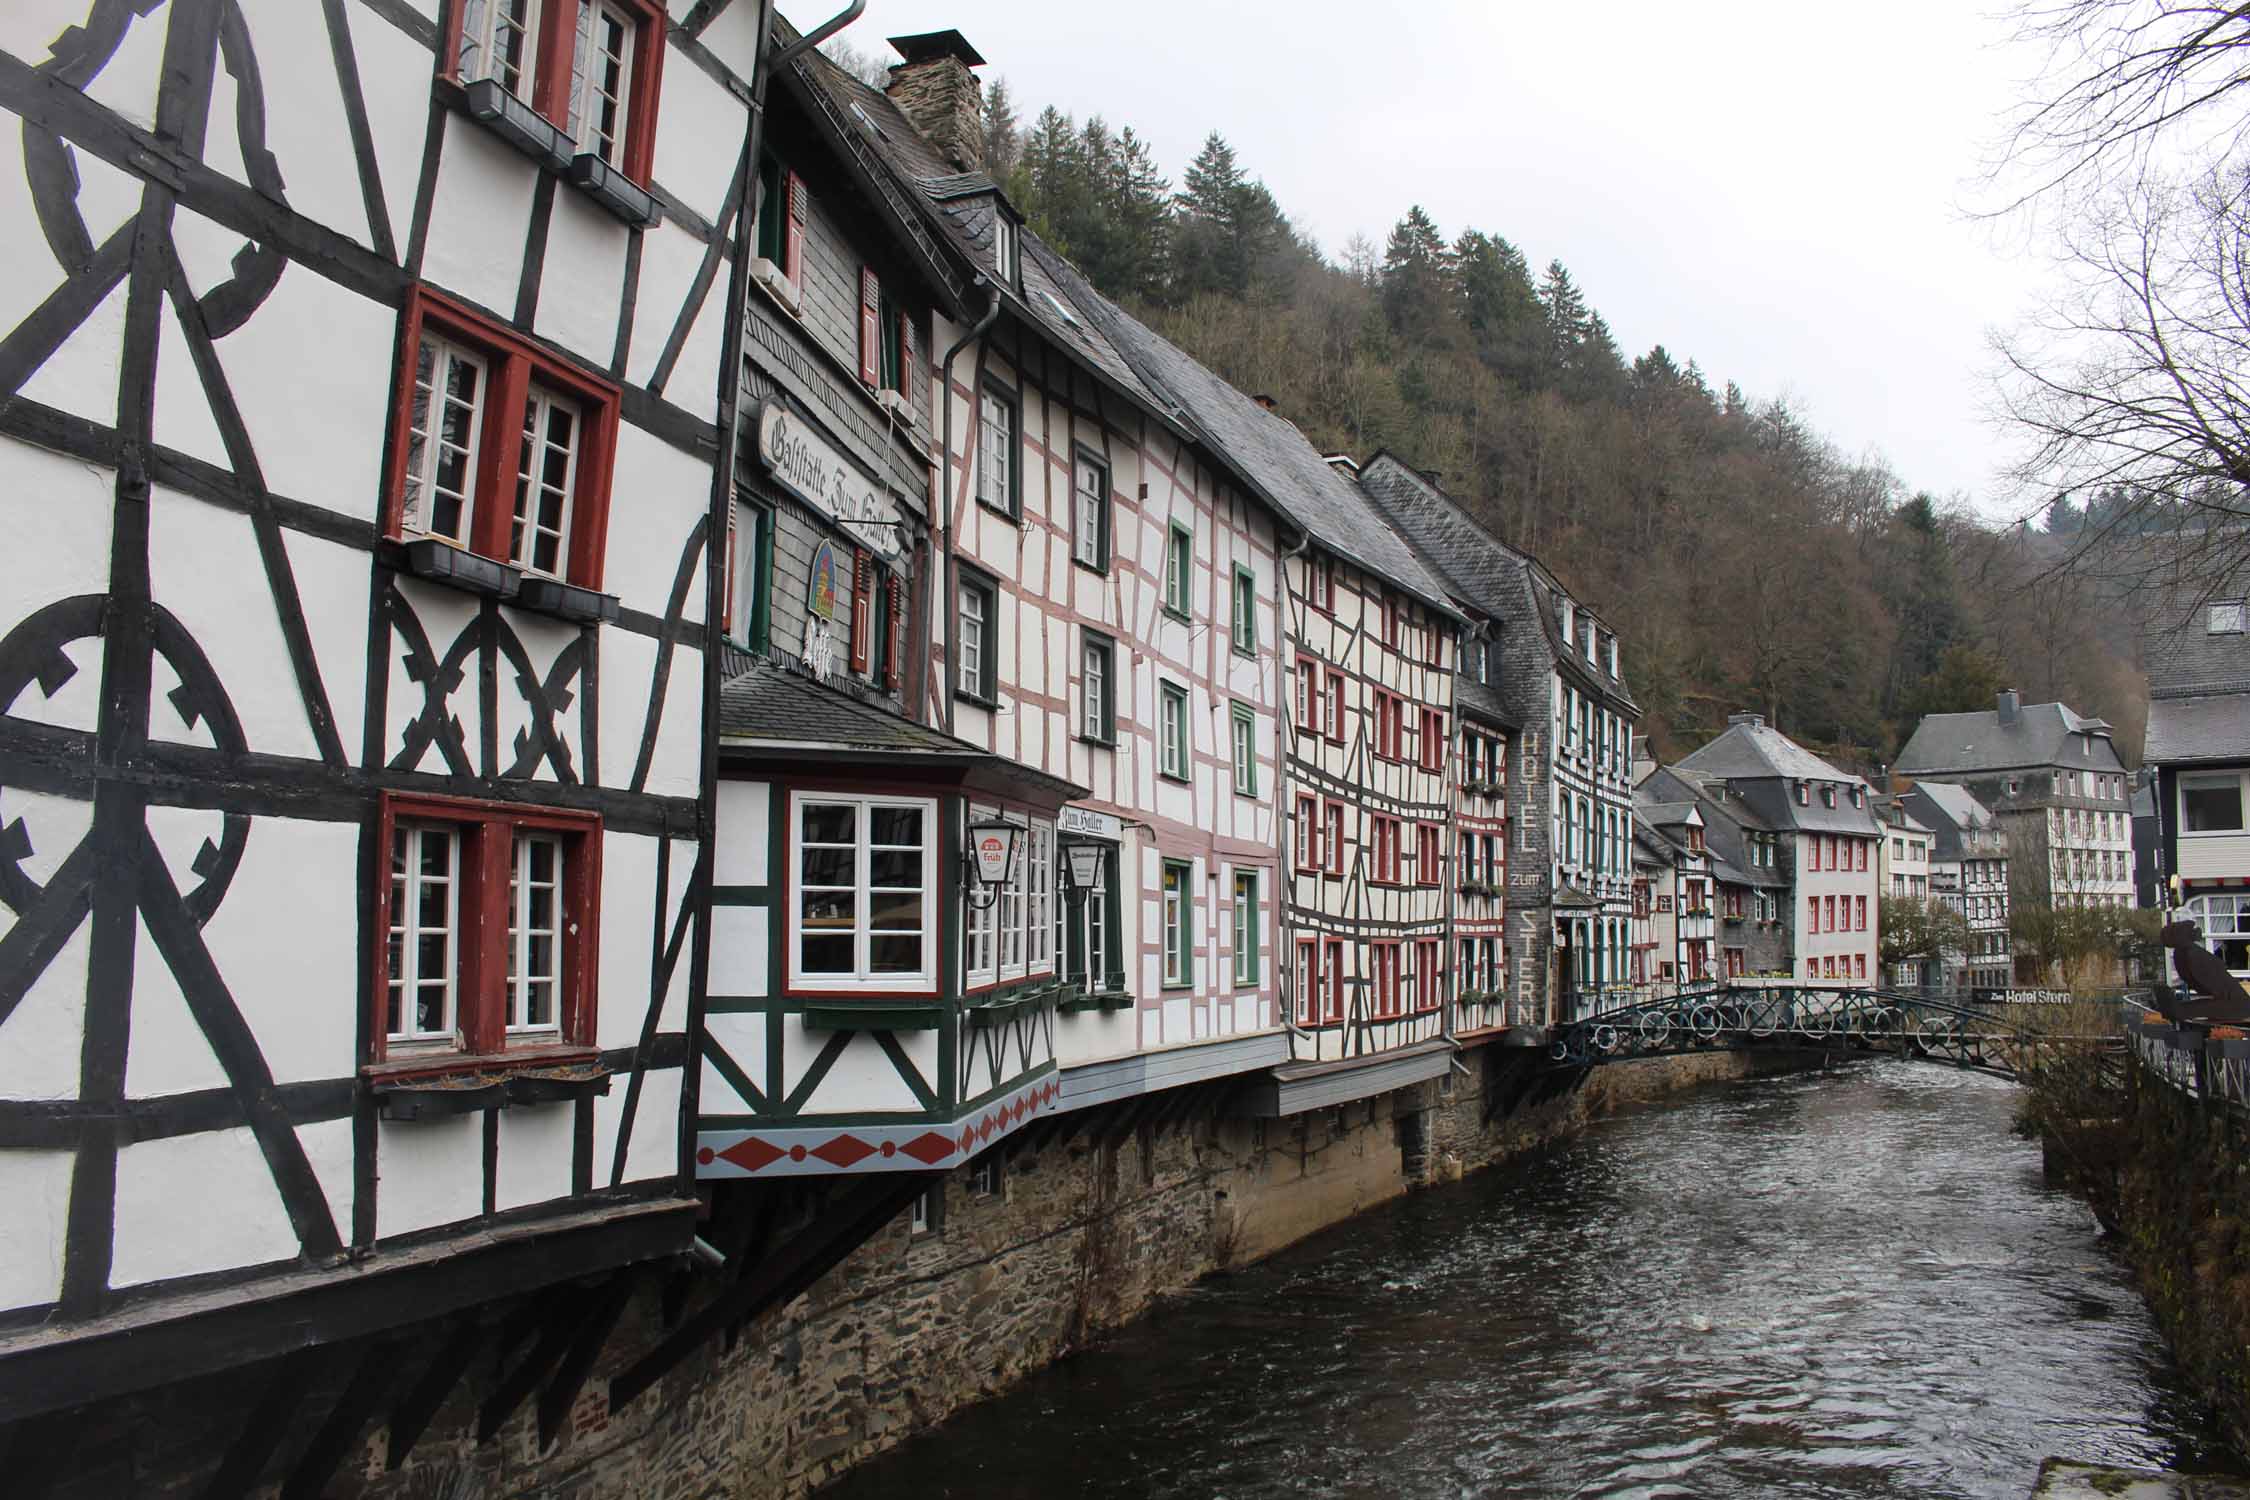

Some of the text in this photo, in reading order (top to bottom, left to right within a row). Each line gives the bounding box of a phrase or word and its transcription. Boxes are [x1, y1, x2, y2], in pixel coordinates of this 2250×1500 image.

[1080, 810, 1103, 832] Haller
[1520, 732, 1538, 853] HOTEL
[1517, 910, 1537, 1026] STERN
[2005, 990, 2036, 1004] Hotel
[2038, 990, 2072, 1004] Stern
